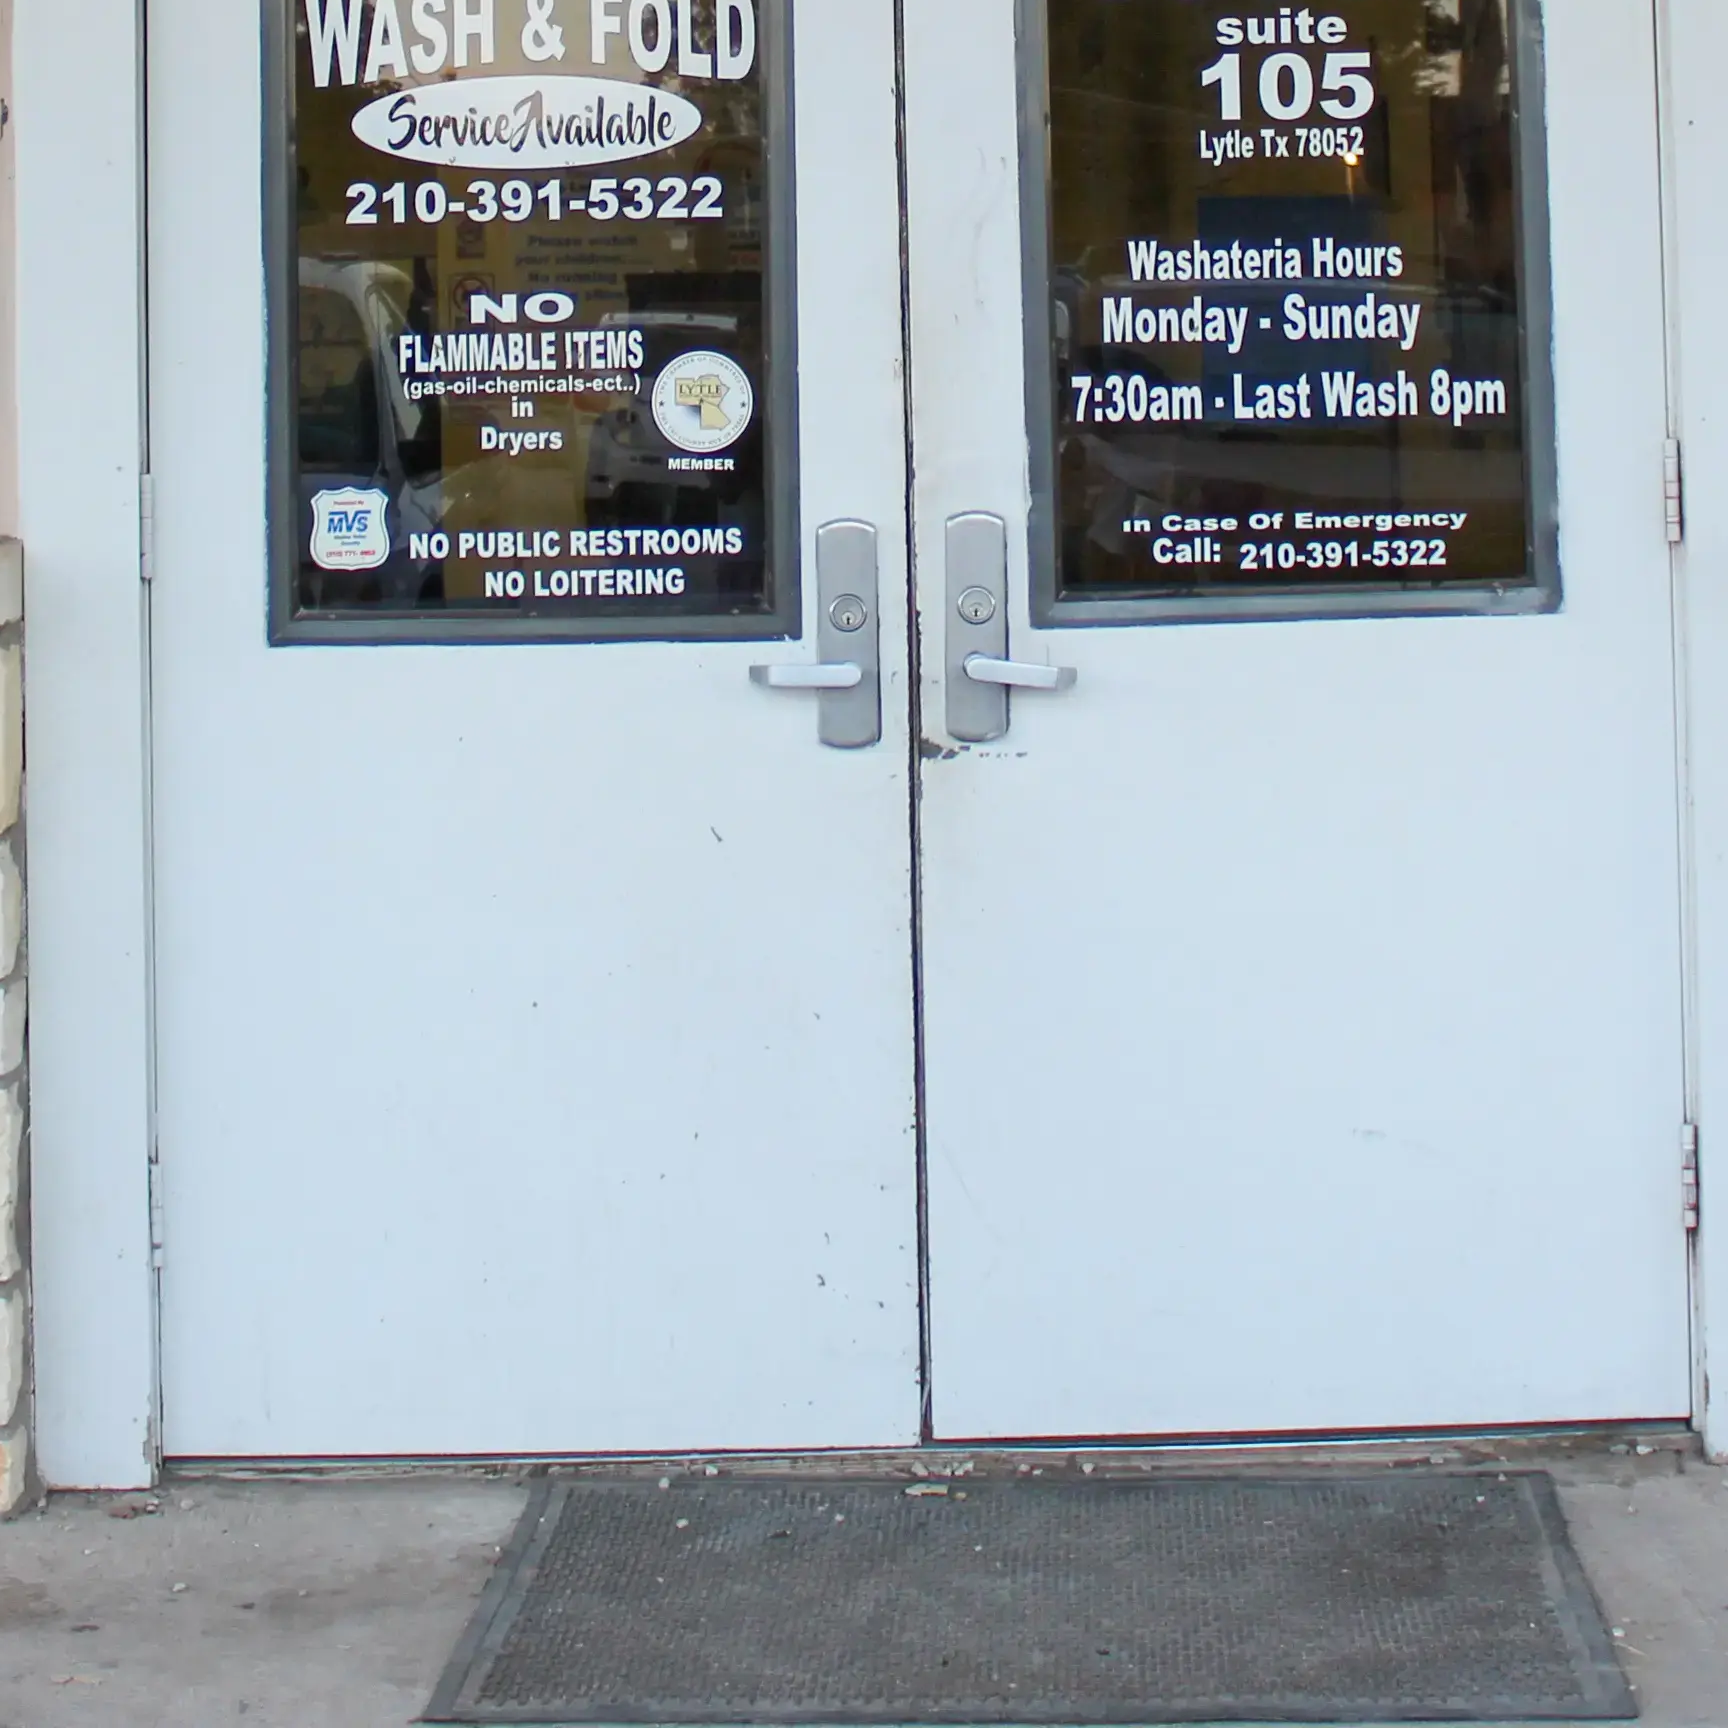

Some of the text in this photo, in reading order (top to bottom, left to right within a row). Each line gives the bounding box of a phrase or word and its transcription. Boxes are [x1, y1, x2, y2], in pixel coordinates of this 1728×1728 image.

[1217, 8, 1347, 45] suite
[1202, 52, 1374, 120] 105
[388, 90, 676, 152] Service Available
[1201, 127, 1364, 166] Lytle Tx 78052
[346, 177, 722, 224] 210-391-5322
[1128, 238, 1402, 280] Washateria Hours
[471, 293, 573, 323] NO
[1103, 296, 1248, 353] Monday
[1284, 293, 1420, 350] Sunday
[400, 330, 643, 372] FLAMMABLE ITEMS
[512, 396, 533, 417] in
[1072, 375, 1202, 422] 7:30am
[1234, 374, 1310, 419] Last
[1321, 370, 1417, 416] Wash
[1431, 369, 1505, 426] 8pm
[482, 427, 562, 455] Dryers
[668, 458, 734, 470] MEMBER
[1163, 515, 1237, 531] Case
[1249, 513, 1283, 529] Of
[1295, 512, 1467, 531] Emergency
[410, 528, 742, 559] NO PUBLIC RESTROOMS
[1153, 537, 1446, 569] Call: 210-391-5322
[486, 569, 684, 597] NO LOITERING
